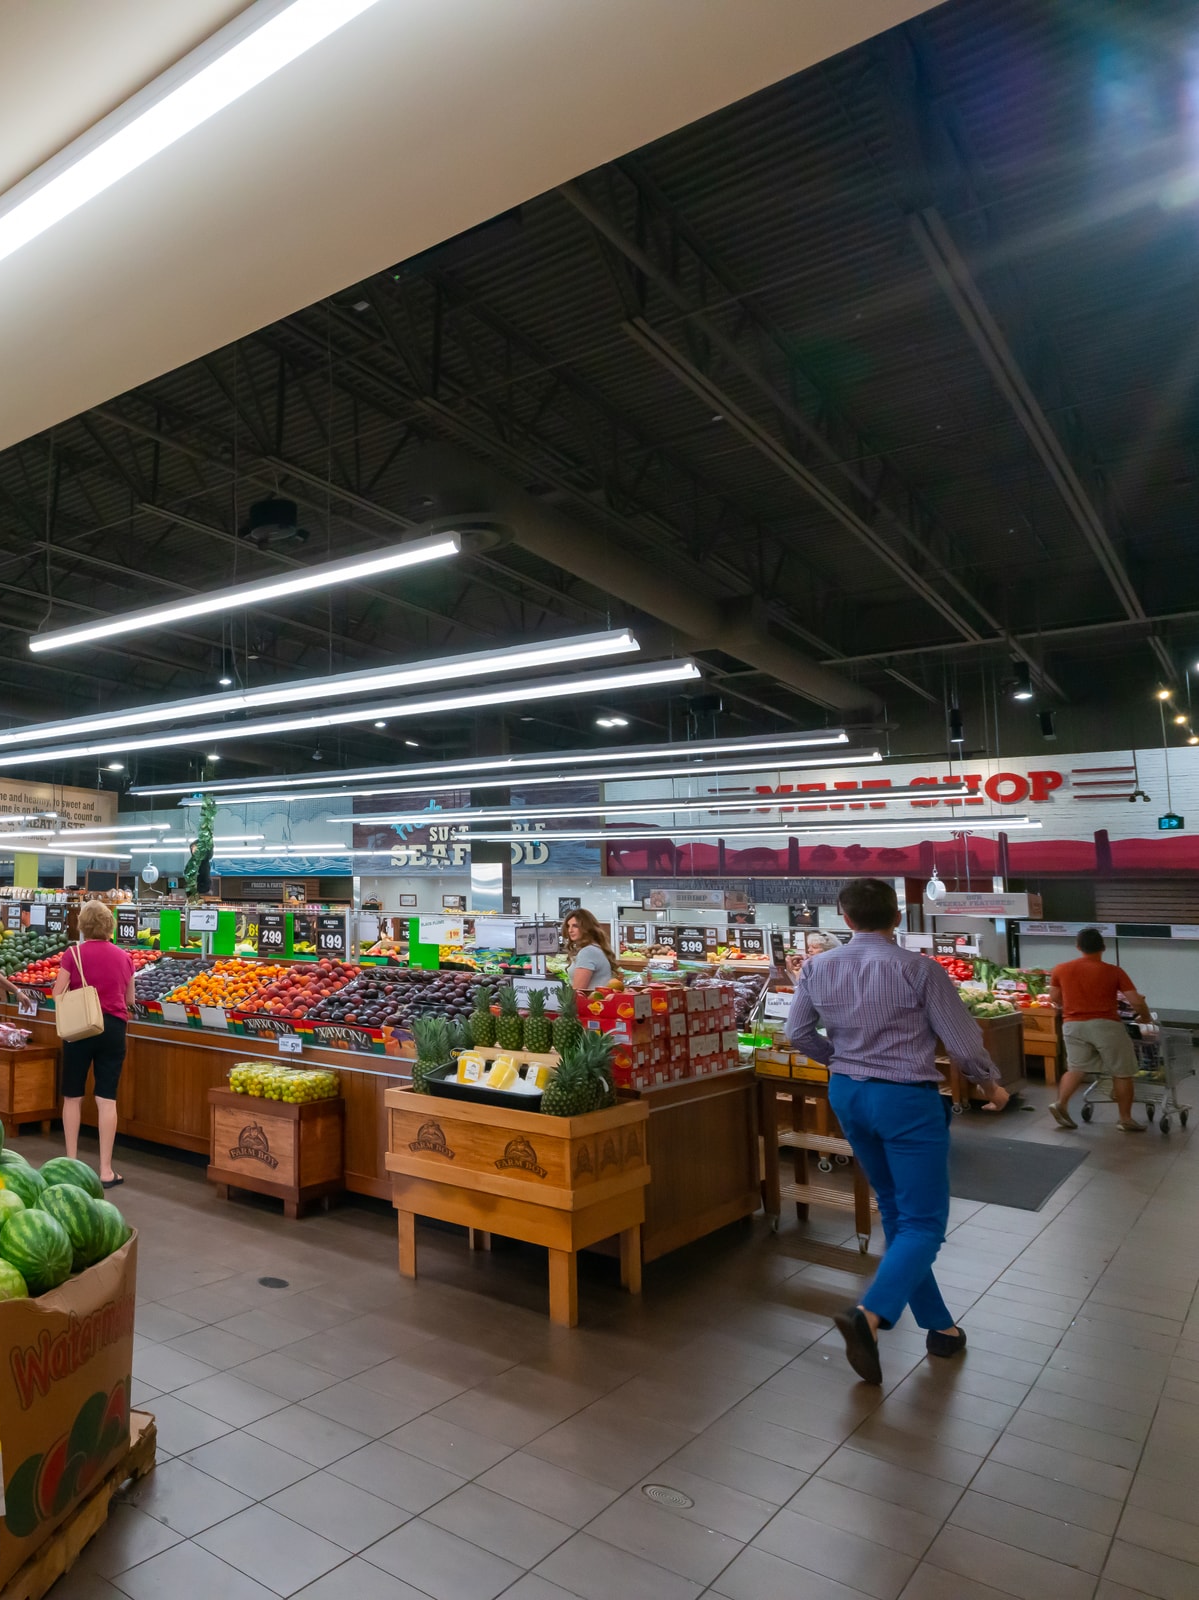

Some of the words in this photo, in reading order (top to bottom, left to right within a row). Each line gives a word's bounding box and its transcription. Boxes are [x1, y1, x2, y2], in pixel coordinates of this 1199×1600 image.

[9, 793, 22, 802] and
[83, 802, 94, 810] and
[391, 842, 549, 866] SEAFOD
[314, 1026, 372, 1048] WAWONA
[231, 1148, 255, 1158] FARM
[258, 1151, 277, 1166] BOY
[497, 1158, 523, 1169] FARM
[525, 1162, 547, 1177] BOY
